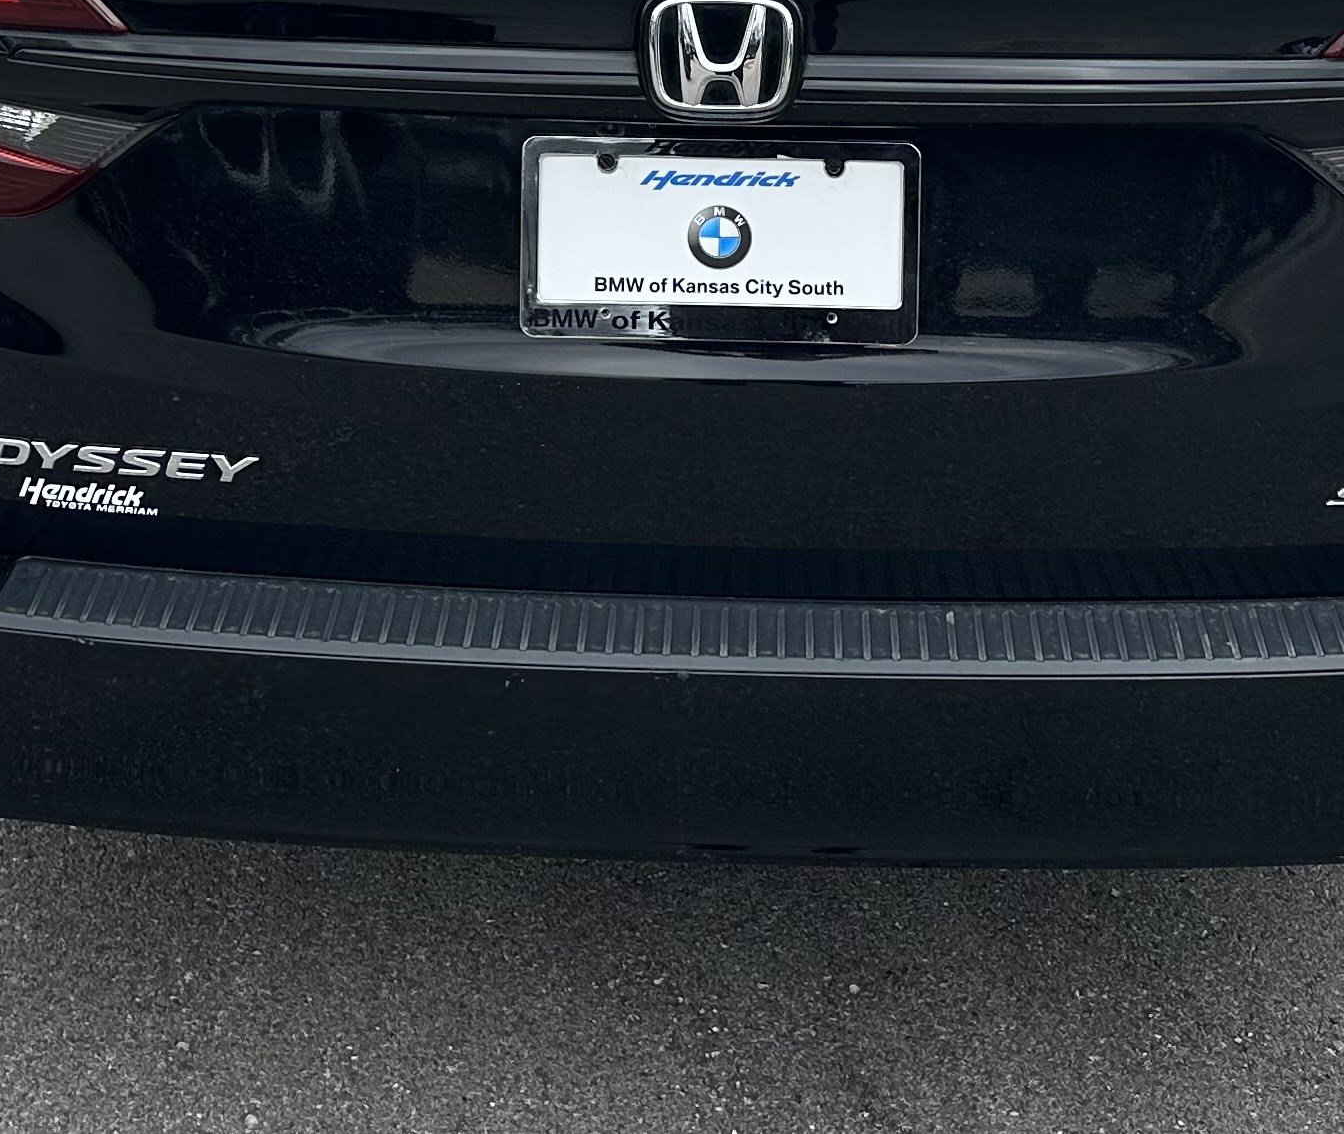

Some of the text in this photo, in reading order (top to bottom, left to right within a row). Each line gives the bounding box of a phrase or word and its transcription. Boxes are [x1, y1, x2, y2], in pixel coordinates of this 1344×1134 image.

[640, 169, 800, 191] Hendrick
[594, 276, 844, 299] BMW of Kansas City South
[532, 308, 599, 329] BMW
[611, 310, 641, 330] of
[18, 476, 144, 507] Hendrick
[45, 499, 159, 516] TOYOTA MERRIAM
